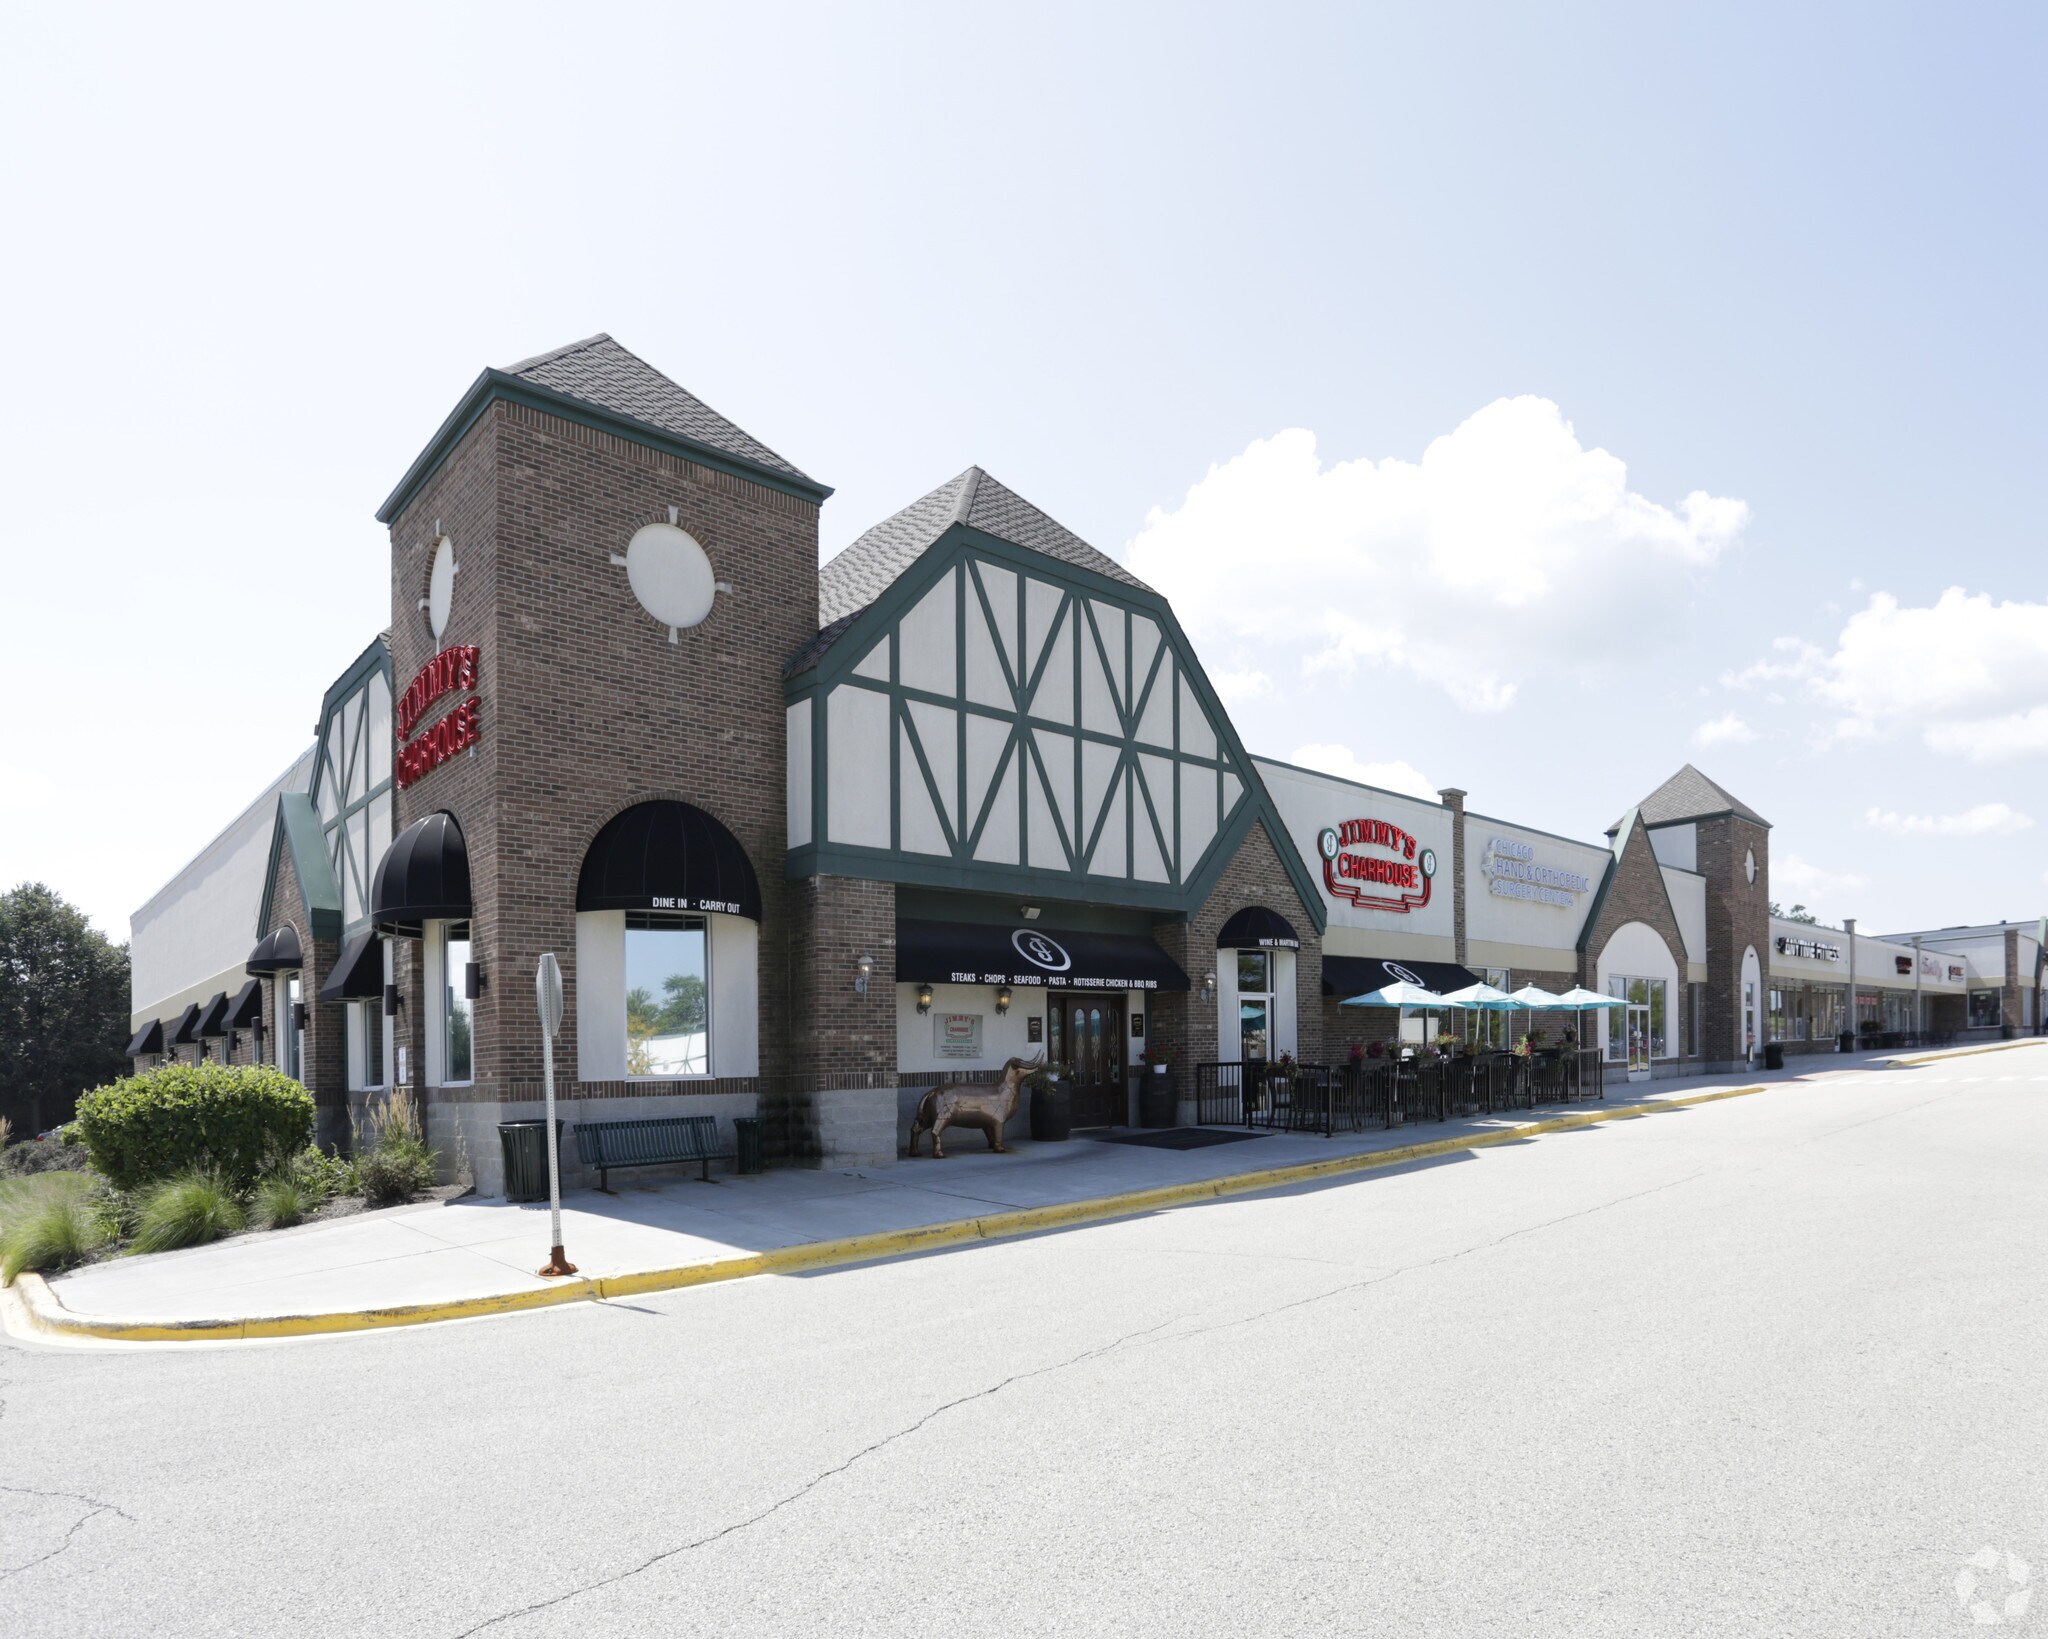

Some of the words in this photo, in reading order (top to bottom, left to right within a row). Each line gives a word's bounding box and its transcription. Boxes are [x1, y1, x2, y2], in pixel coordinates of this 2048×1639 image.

[396, 645, 480, 742] JIMMY'S
[1339, 819, 1417, 861] JIMMY'S
[1495, 839, 1534, 861] CHICAGO
[1338, 852, 1418, 889] CHARHOUSE
[1496, 858, 1525, 879] HAND
[1526, 865, 1533, 880] &
[1534, 866, 1589, 893] ORTHOPEDIC
[652, 897, 675, 908] DINE
[678, 898, 688, 909] IN
[700, 899, 726, 912] CARRY
[727, 902, 740, 914] OUT
[1496, 879, 1538, 900] SURGERY
[1538, 887, 1574, 907] CENTERS
[1259, 938, 1273, 946] WINE
[1274, 938, 1279, 946] &
[951, 972, 976, 982] STEAKS
[984, 973, 1006, 984] CHOPS
[1013, 975, 1041, 985] SEAFOOD
[1049, 976, 1067, 986] PASTA
[1073, 977, 1105, 987] ROTISSERIE
[1105, 979, 1128, 988] CHICKEN
[1128, 980, 1133, 988] &
[1134, 980, 1145, 989] BBQ
[1145, 980, 1157, 989] RIBS
